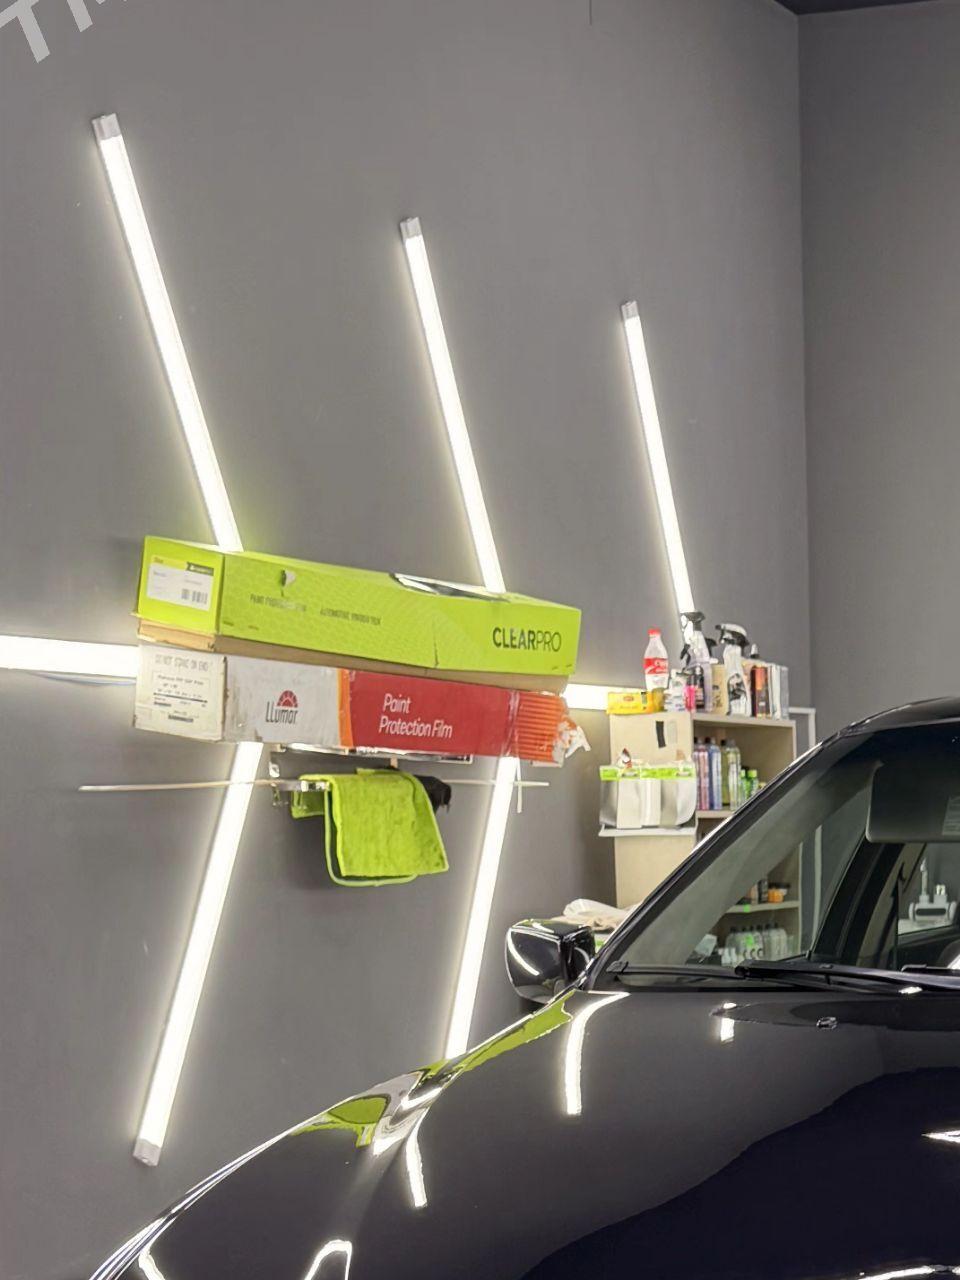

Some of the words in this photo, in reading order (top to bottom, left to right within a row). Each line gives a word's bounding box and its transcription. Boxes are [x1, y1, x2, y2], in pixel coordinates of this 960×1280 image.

[492, 627, 562, 653] CLEARPRO
[266, 701, 298, 725] LLumar
[383, 693, 412, 715] Paint
[379, 716, 431, 737] Protection
[431, 719, 453, 739] Film
